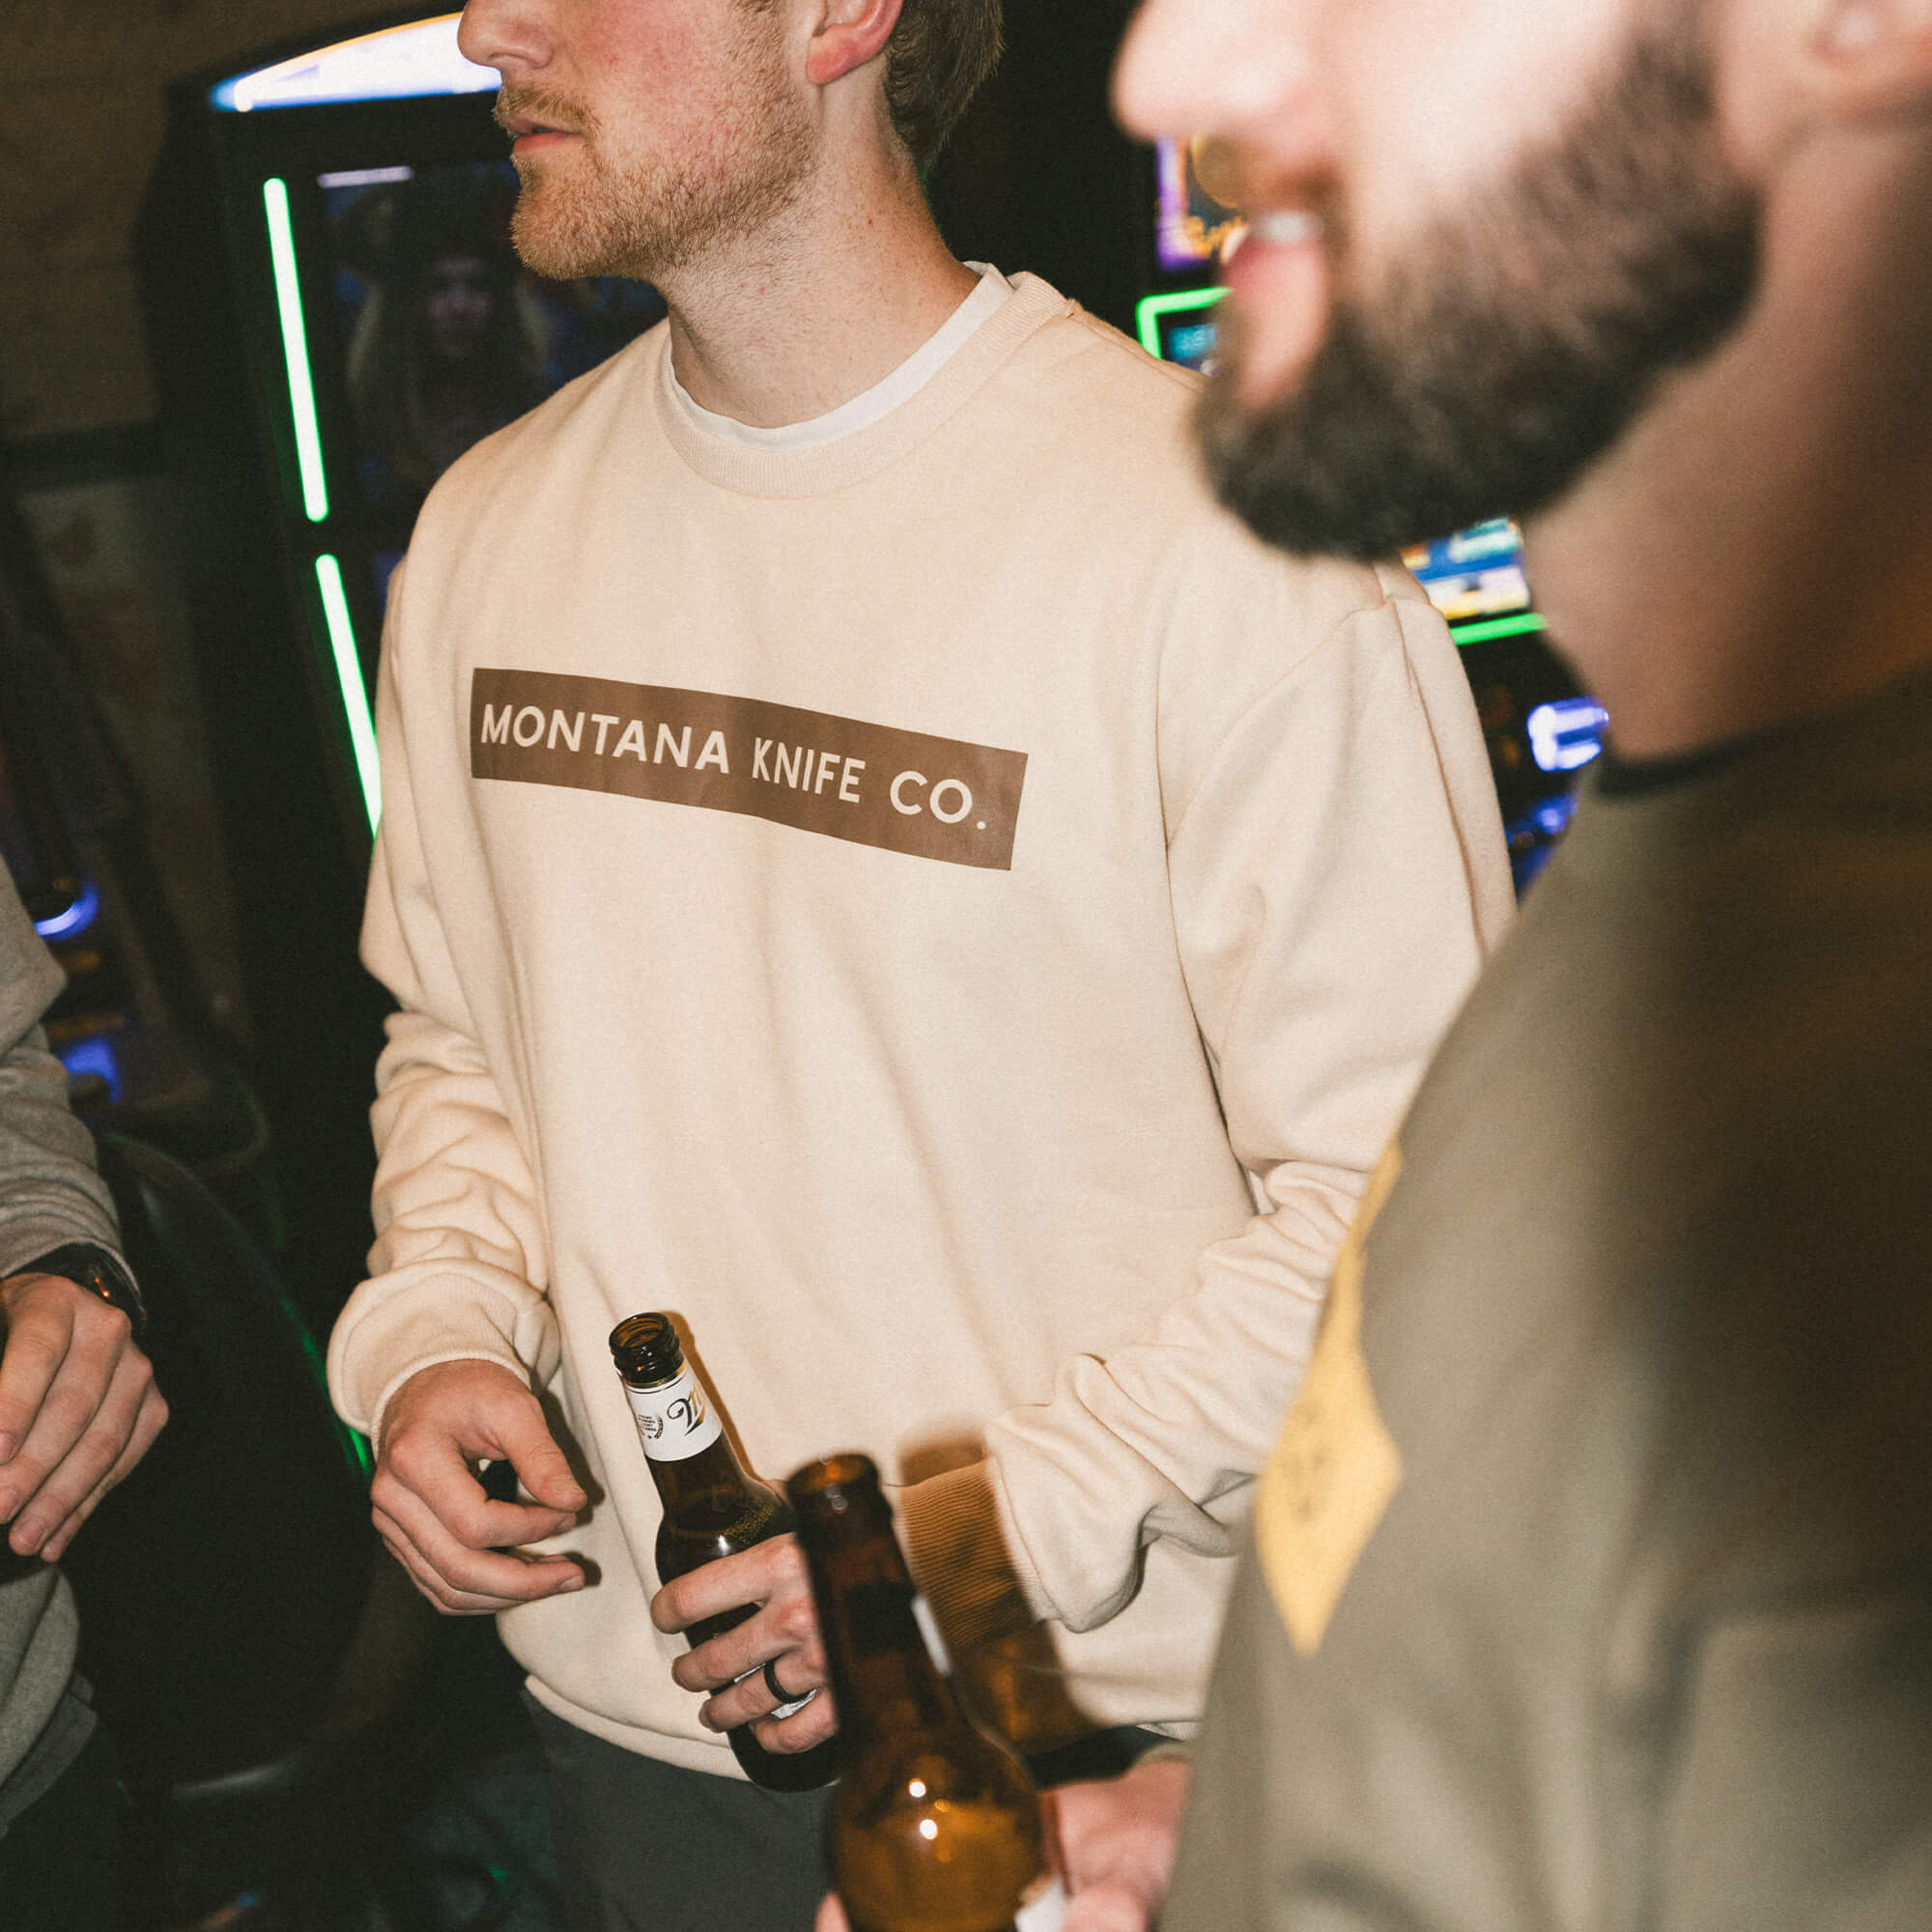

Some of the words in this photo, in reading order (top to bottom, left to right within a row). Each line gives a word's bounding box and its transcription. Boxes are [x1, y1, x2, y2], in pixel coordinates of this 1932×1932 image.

[481, 703, 729, 774] MONTANA
[752, 737, 867, 804] KNIFE
[890, 770, 987, 831] CO.
